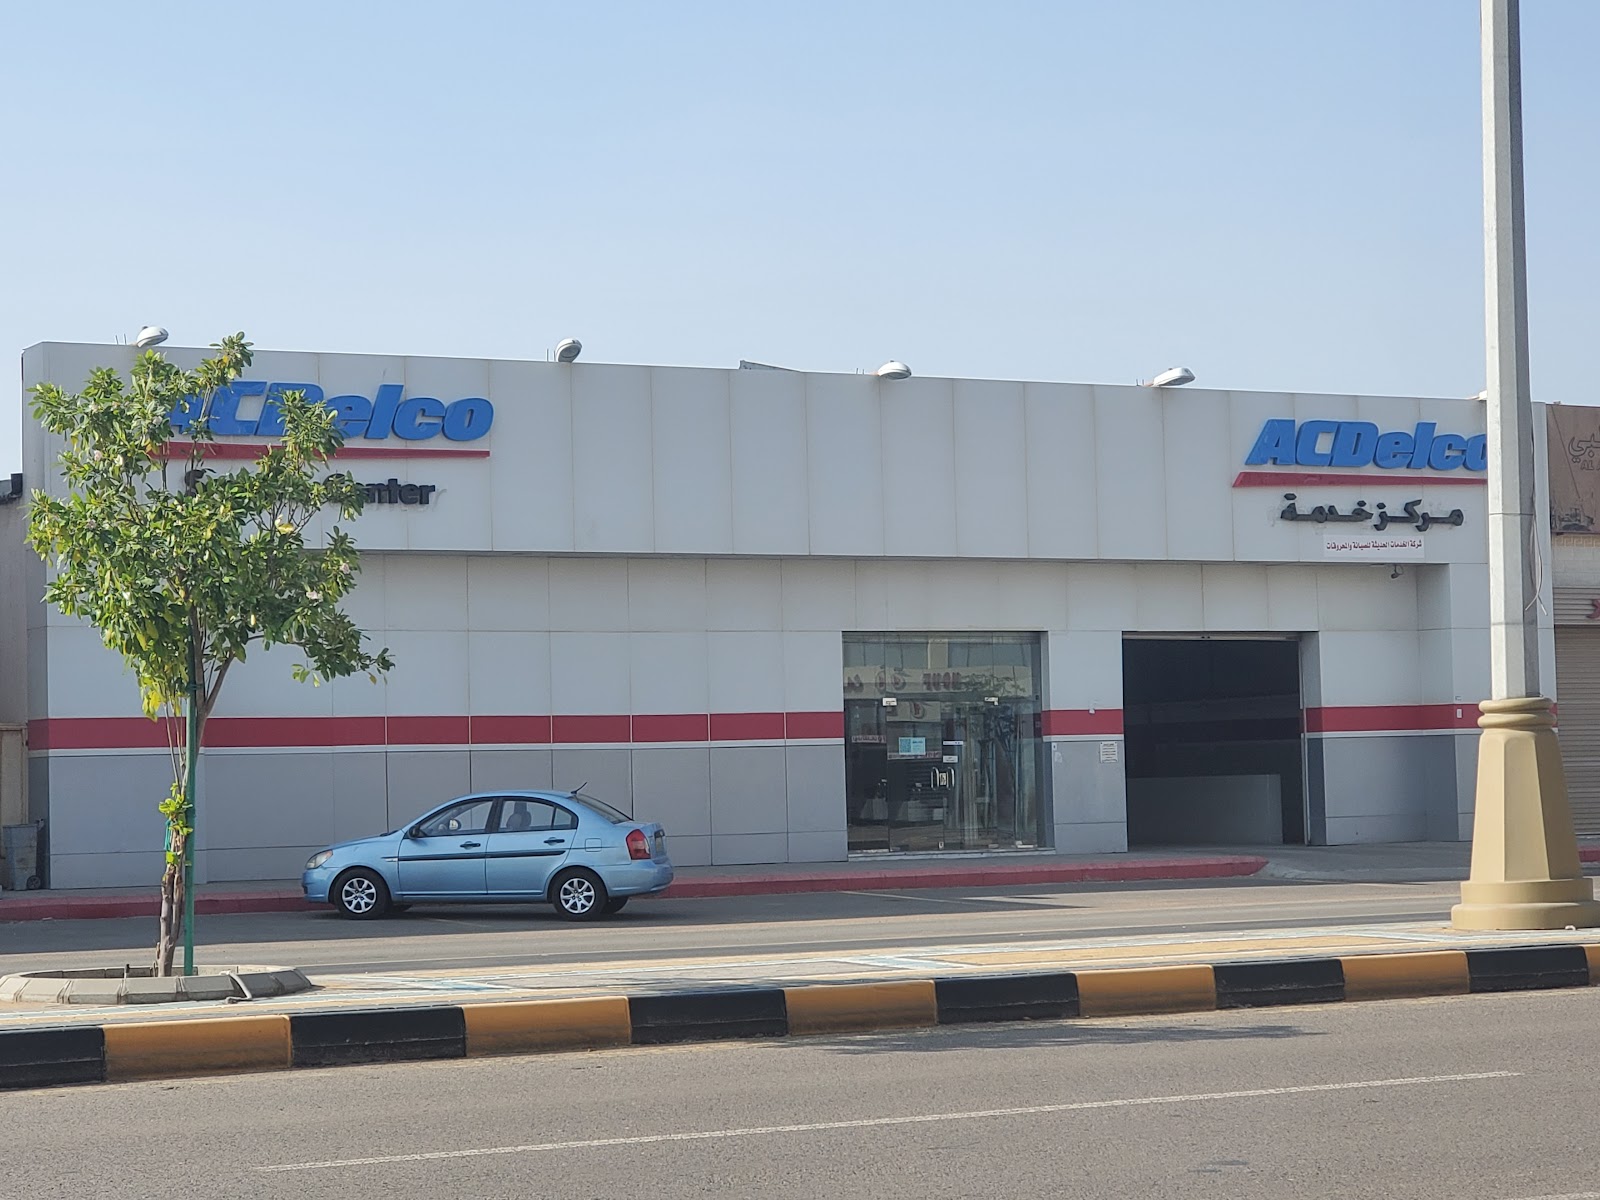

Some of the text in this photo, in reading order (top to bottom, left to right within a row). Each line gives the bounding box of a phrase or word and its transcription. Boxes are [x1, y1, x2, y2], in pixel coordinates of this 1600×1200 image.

[322, 473, 436, 505] nter
[1280, 493, 1464, 532] مركز خدمة
[1410, 539, 1422, 549] شركة
